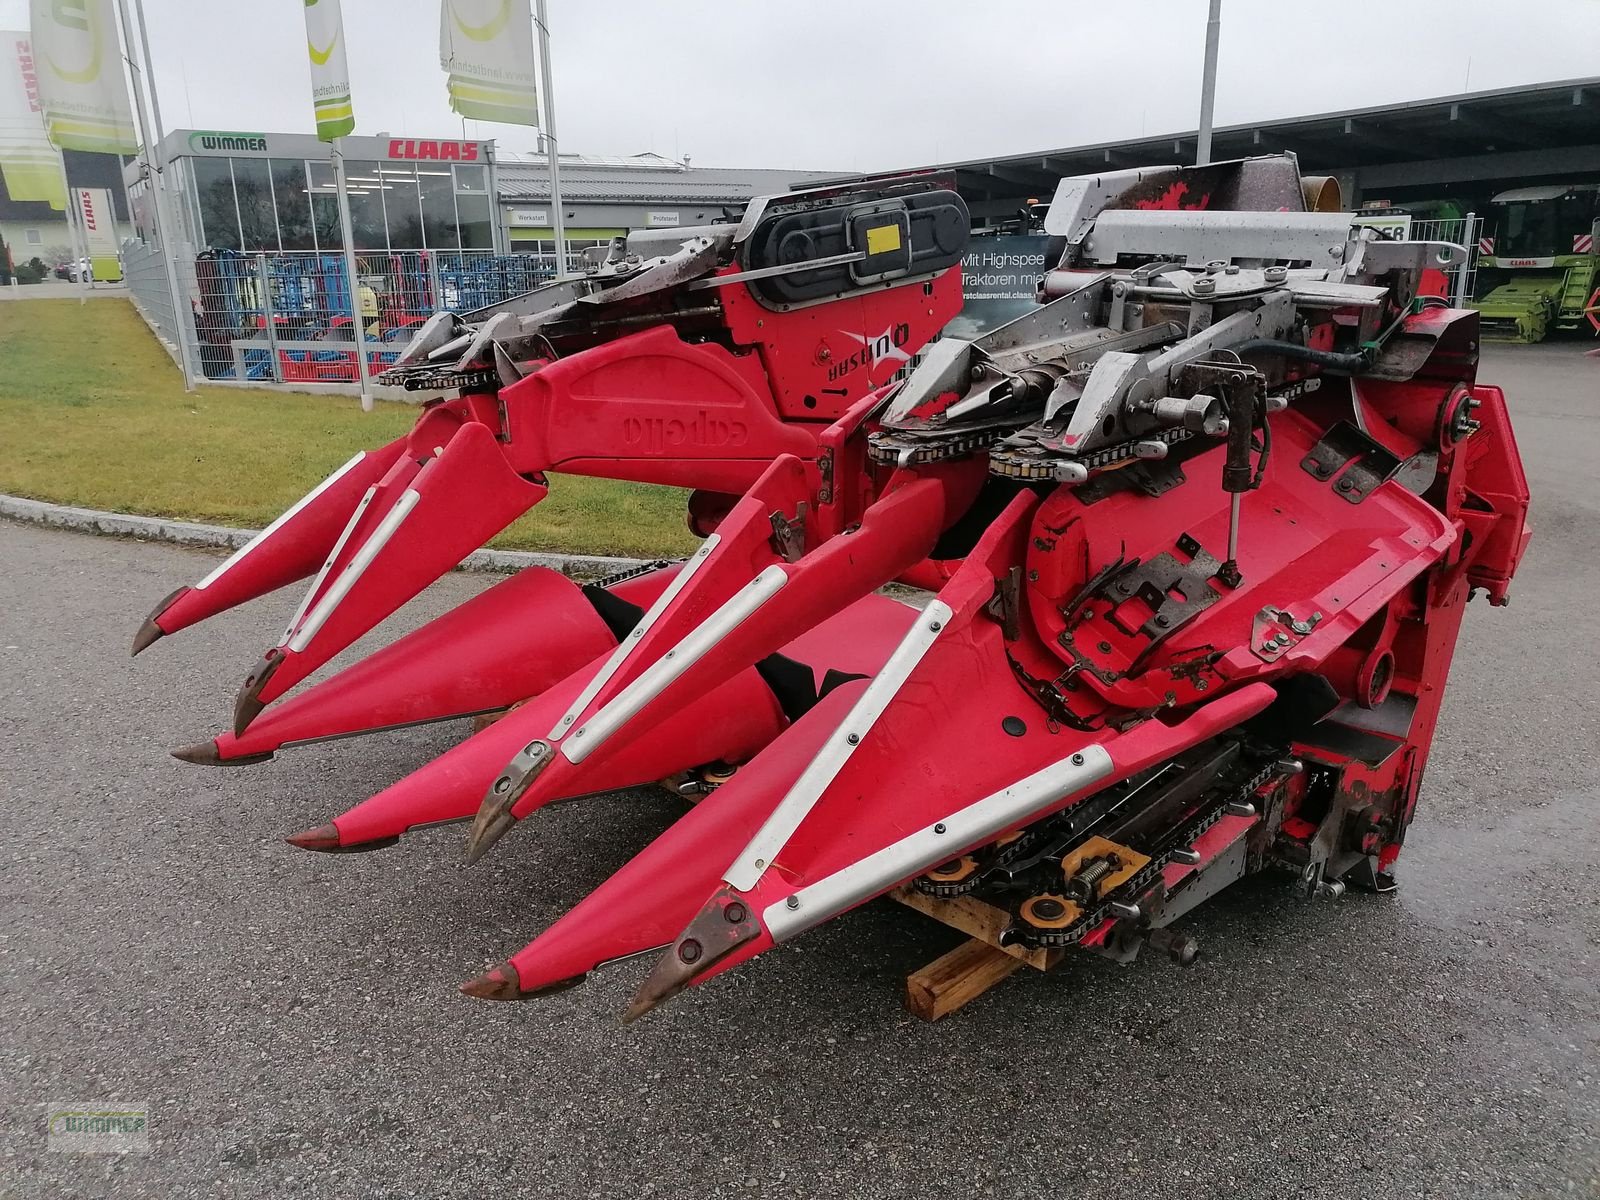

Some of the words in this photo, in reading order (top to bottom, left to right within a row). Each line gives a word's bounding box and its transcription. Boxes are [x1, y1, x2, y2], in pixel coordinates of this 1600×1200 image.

[201, 136, 267, 151] WIMMER
[388, 140, 478, 160] CLAAS
[82, 191, 97, 231] CLAAS
[960, 253, 980, 267] Mit
[983, 252, 1045, 269] Highspee
[961, 272, 1017, 286] Traktoren
[829, 323, 910, 382] QUASAR
